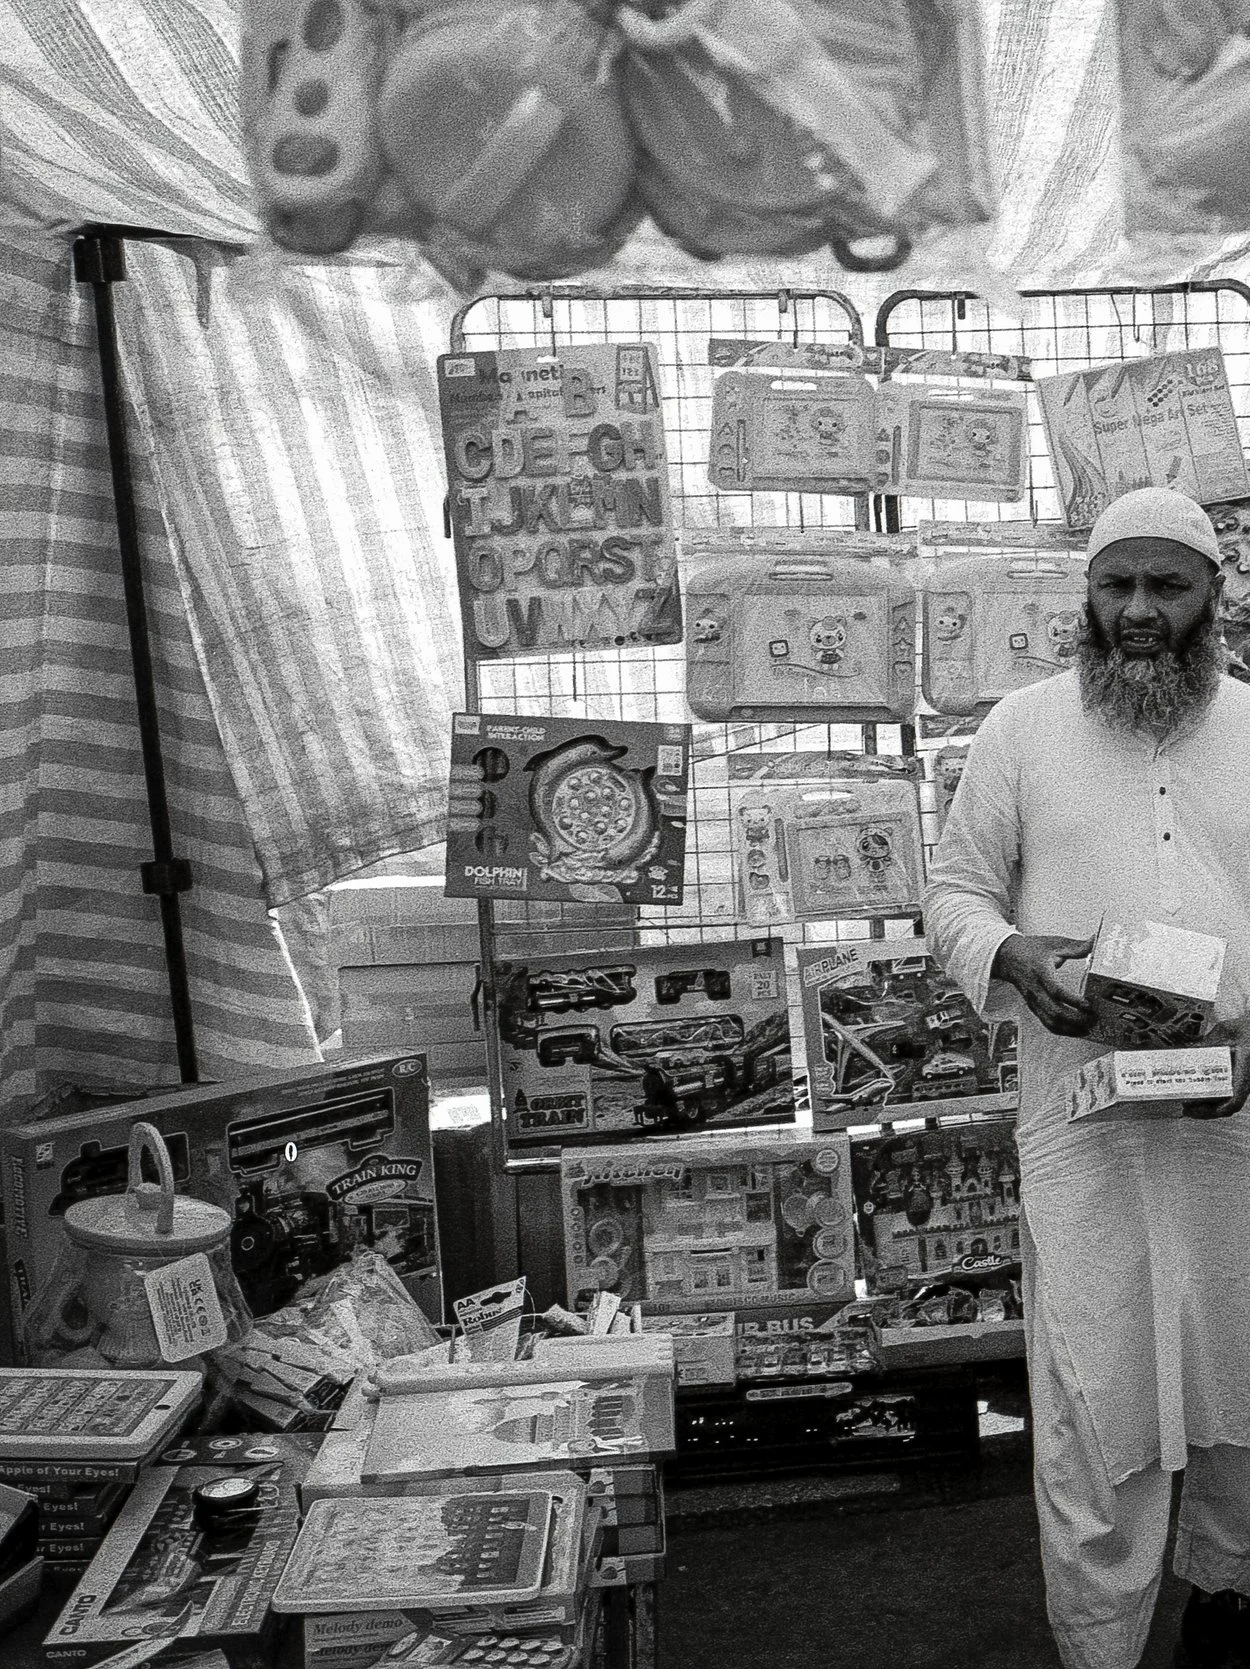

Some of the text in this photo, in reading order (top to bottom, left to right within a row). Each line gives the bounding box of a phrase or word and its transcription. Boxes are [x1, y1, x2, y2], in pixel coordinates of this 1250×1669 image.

[1092, 418, 1129, 436] Super
[1186, 403, 1208, 416] Set
[486, 724, 547, 735] PARENT-CHILD
[487, 732, 546, 742] INTERACTION
[464, 865, 522, 879] DOLPHIN
[474, 876, 495, 885] FISH
[651, 884, 666, 899] 12
[803, 947, 859, 980] AIRPLANE
[331, 1166, 377, 1195] TRAIN
[380, 1163, 418, 1177] KING
[960, 1255, 1003, 1272] Castle
[456, 1297, 476, 1311] AA
[766, 1316, 815, 1333] BUS
[36, 1466, 51, 1476] of
[53, 1466, 82, 1477] Your
[84, 1467, 120, 1479] Eyes!
[42, 1501, 79, 1514] Eyes!
[49, 1521, 86, 1533] Eyes!
[49, 1542, 85, 1555] Eyes!
[58, 1594, 98, 1636] CANTO
[313, 1617, 404, 1636] Melody demo
[45, 1648, 87, 1660] CANTO
